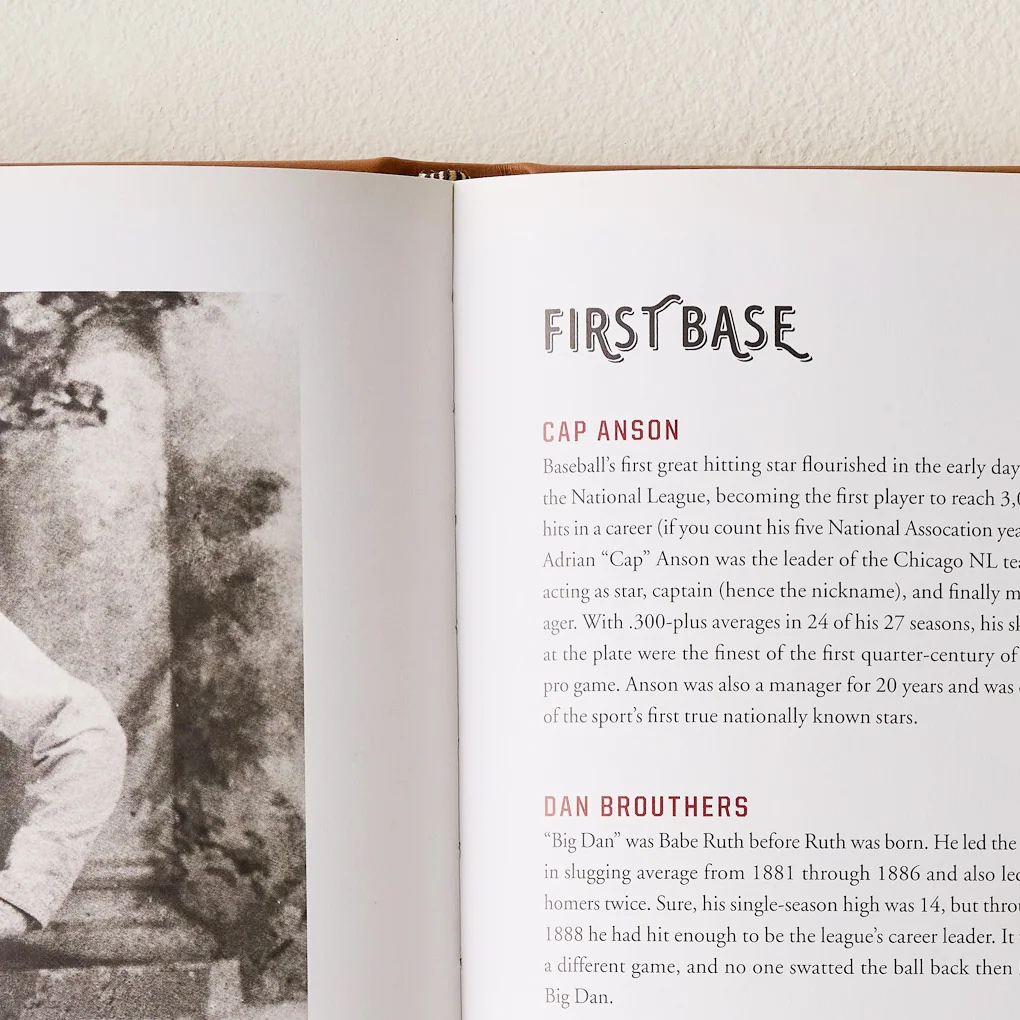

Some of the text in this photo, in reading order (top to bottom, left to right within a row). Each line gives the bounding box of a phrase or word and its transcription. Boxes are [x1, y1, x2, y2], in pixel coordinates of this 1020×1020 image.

[544, 293, 813, 363] FIRST BASE
[542, 419, 679, 443] CAP ANSON
[542, 488, 567, 506] the
[570, 486, 642, 505] National
[646, 487, 711, 510] League,
[715, 485, 801, 510] becoming
[804, 486, 832, 504] the
[836, 486, 870, 505] first
[873, 487, 926, 510] player
[929, 493, 947, 506] to
[951, 488, 996, 506] reach
[542, 582, 591, 605] acting
[594, 587, 610, 599] as
[613, 586, 647, 600] star,
[652, 581, 714, 604] captain
[719, 580, 775, 601] (hence
[779, 580, 807, 599] the
[811, 580, 907, 603] nickname),
[912, 582, 944, 600] and
[948, 581, 1002, 606] finally
[543, 649, 558, 662] at
[562, 643, 588, 662] the
[592, 643, 633, 667] plate
[636, 649, 677, 661] were
[682, 643, 709, 661] the
[714, 642, 761, 661] finest
[766, 643, 787, 661] of
[789, 643, 817, 661] the
[822, 643, 856, 662] first
[860, 649, 996, 668] quarter-century
[1000, 645, 1020, 663] of
[543, 681, 570, 698] pro
[573, 681, 620, 698] game.
[624, 675, 679, 693] Anson
[682, 681, 714, 692] was
[718, 674, 751, 693] also
[755, 681, 765, 693] a
[768, 681, 843, 699] manager
[846, 675, 872, 693] for
[875, 676, 898, 694] 20
[901, 682, 944, 699] years
[948, 676, 980, 694] and
[983, 683, 1014, 695] was
[544, 795, 748, 817] DAN BROUTHERS
[544, 863, 559, 880] in
[563, 862, 632, 886] slugging
[636, 868, 699, 886] average
[703, 862, 746, 881] from
[753, 864, 794, 881] 1881
[801, 863, 871, 887] through
[878, 864, 921, 882] 1886
[926, 864, 959, 882] and
[963, 864, 996, 882] also
[544, 961, 553, 973] a
[557, 955, 626, 974] different
[631, 962, 681, 979] game,
[686, 956, 719, 975] and
[724, 963, 747, 975] no
[752, 963, 784, 975] one
[789, 957, 855, 975] swatted
[860, 957, 888, 975] the
[893, 957, 925, 976] ball
[929, 957, 970, 976] back
[975, 957, 1013, 976] then
[544, 987, 614, 1010] Big Dan.
